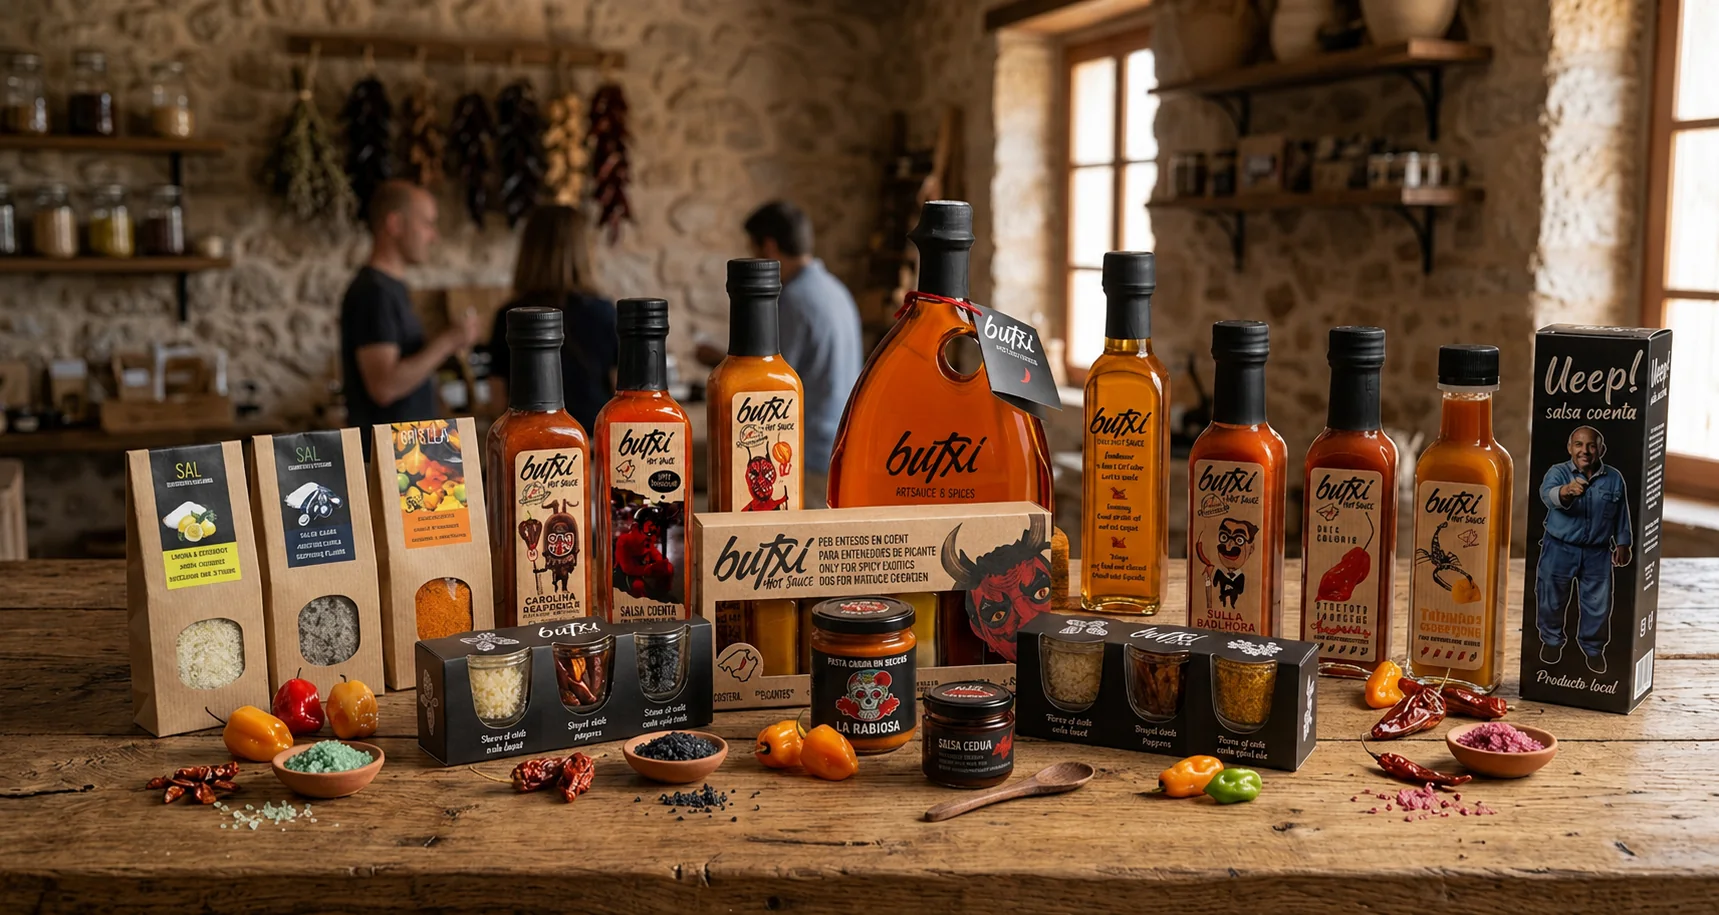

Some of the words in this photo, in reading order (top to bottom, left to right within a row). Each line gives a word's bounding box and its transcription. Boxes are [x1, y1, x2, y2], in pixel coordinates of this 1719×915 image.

[1545, 349, 1644, 405] Ueep!
[1546, 402, 1581, 420] salsa
[1586, 402, 1638, 421] coenta
[296, 446, 321, 463] SAL
[886, 430, 988, 484] butxi
[175, 461, 202, 479] SAL
[948, 488, 975, 499] SPICES
[871, 535, 882, 545] EN
[819, 550, 839, 561] PARA
[904, 546, 936, 557] PICANTE
[713, 533, 815, 591] butxi
[819, 563, 839, 574] ONLY
[858, 561, 881, 572] SPICY
[620, 605, 644, 617] SALSA
[1207, 609, 1243, 622] SULLA
[1536, 669, 1588, 690] Producto
[1590, 681, 1619, 694] local
[836, 721, 850, 734] LA
[853, 720, 901, 735] RABIOSA
[963, 740, 992, 751] CEDUA
